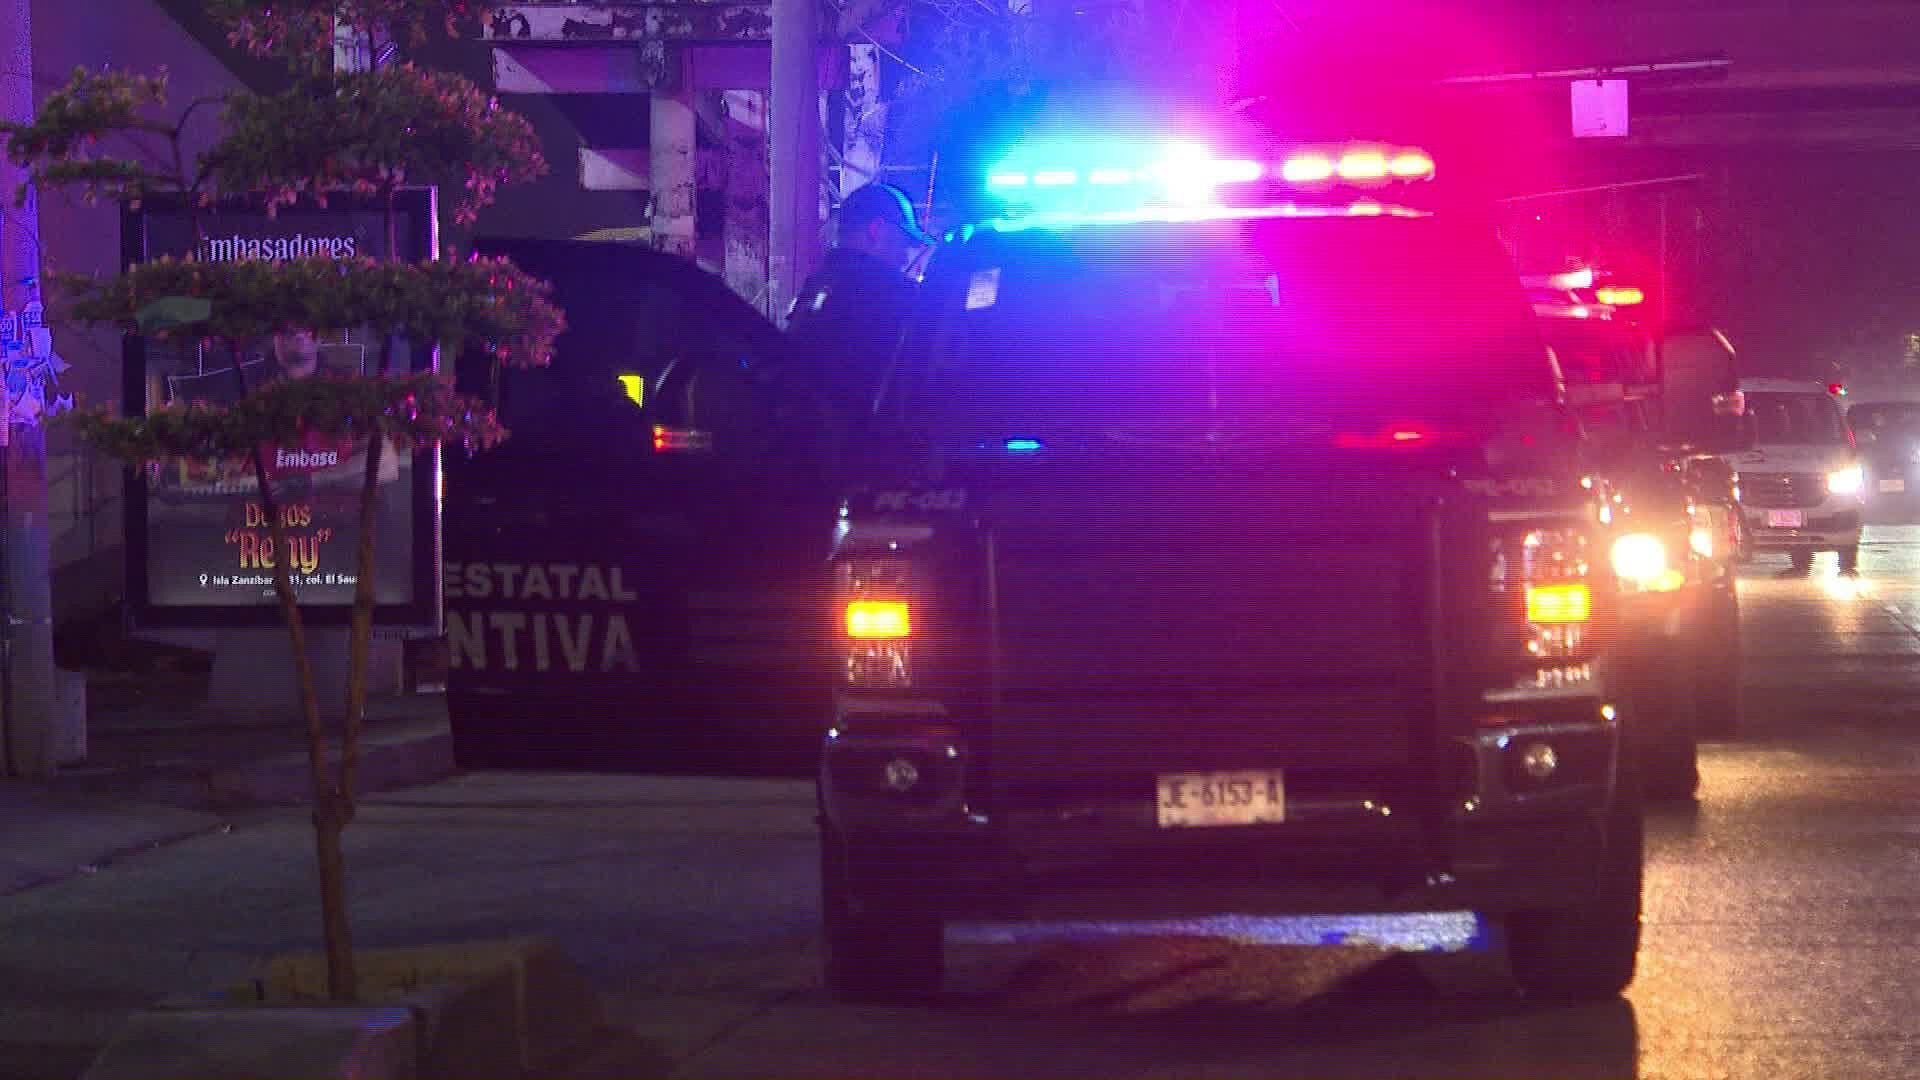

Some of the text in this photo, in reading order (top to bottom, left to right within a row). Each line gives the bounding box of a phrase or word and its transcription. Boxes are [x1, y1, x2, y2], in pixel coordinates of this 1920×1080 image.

[276, 448, 337, 468] Embasa
[213, 575, 230, 585] Isla
[231, 575, 274, 585] Zanzibar
[445, 562, 638, 601] ESTATAL
[446, 611, 641, 672] NTIVA
